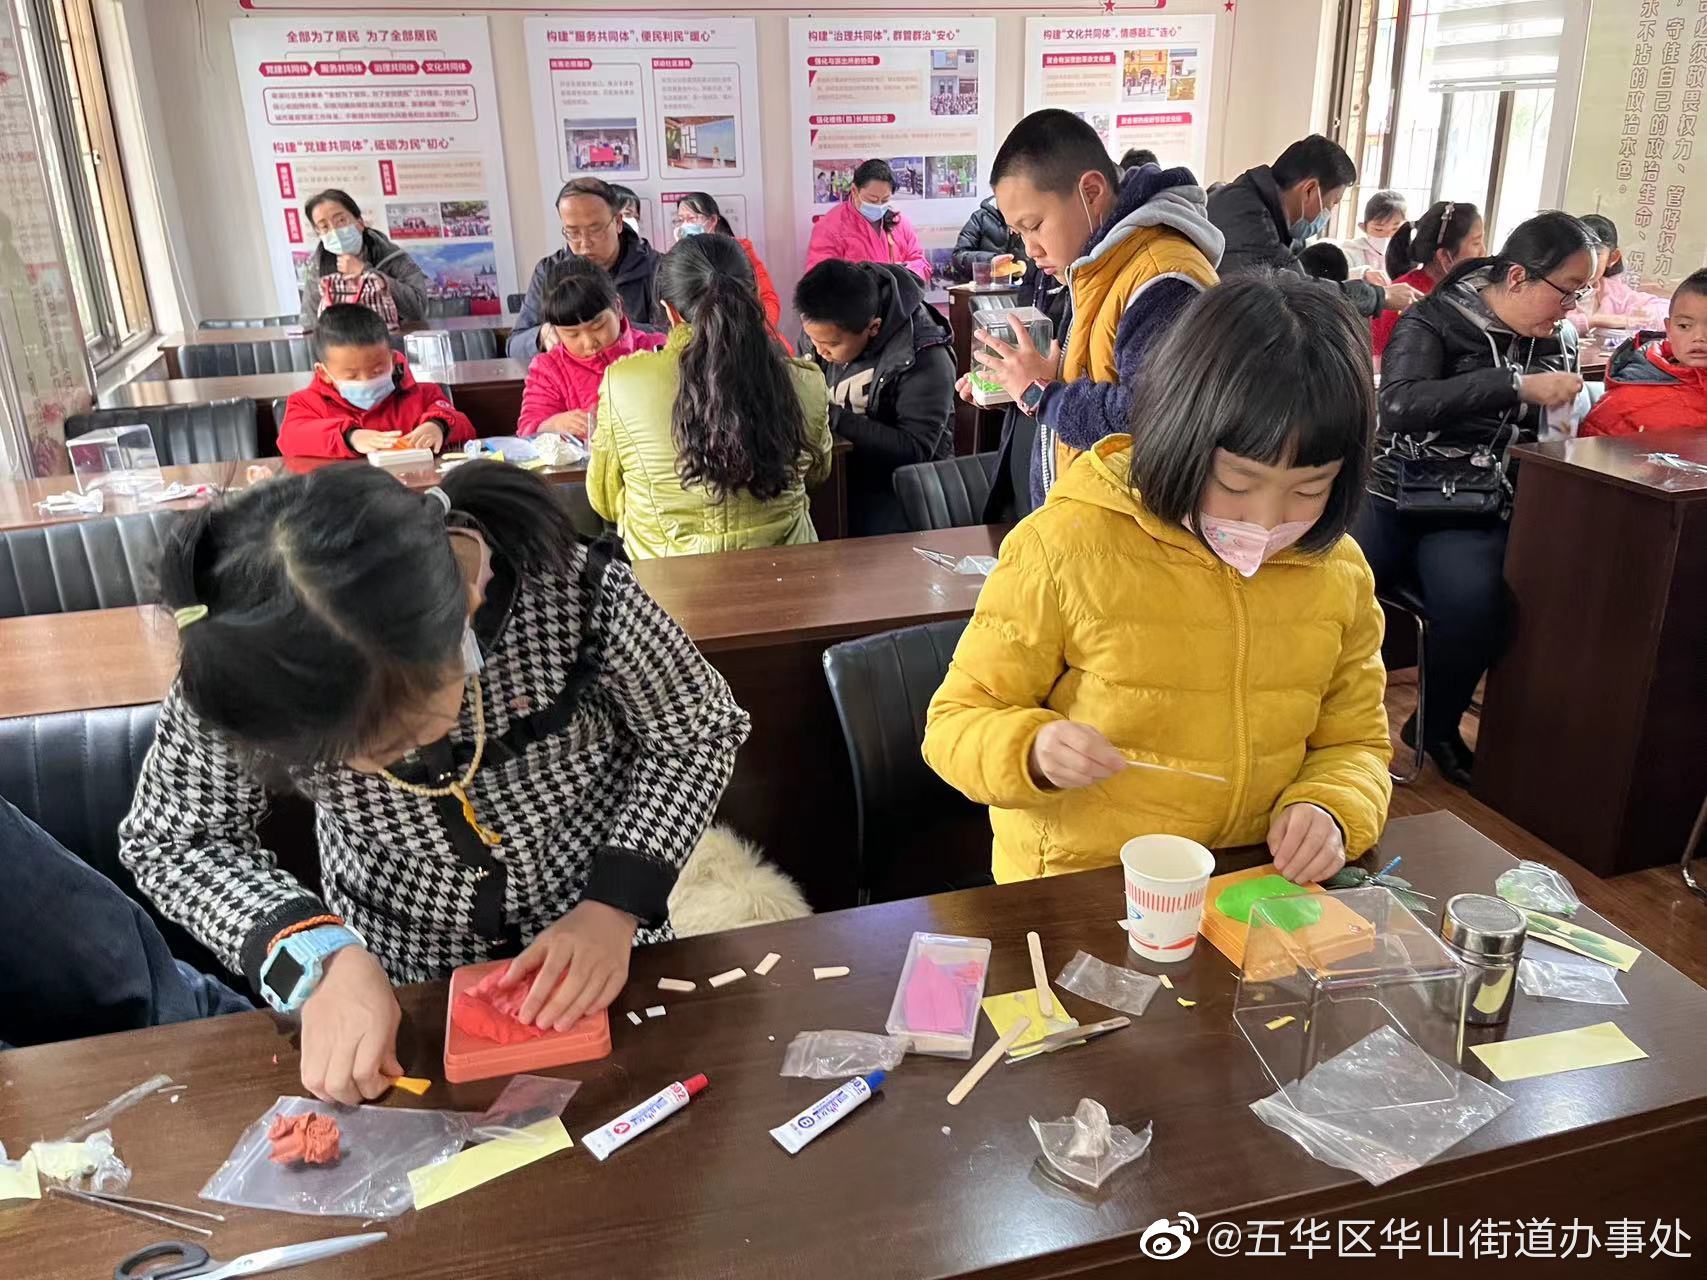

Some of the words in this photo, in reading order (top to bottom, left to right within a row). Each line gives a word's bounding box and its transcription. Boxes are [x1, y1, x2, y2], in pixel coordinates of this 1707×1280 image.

[286, 31, 360, 43] 全部为了居民
[366, 30, 438, 42] 为了全部居民
